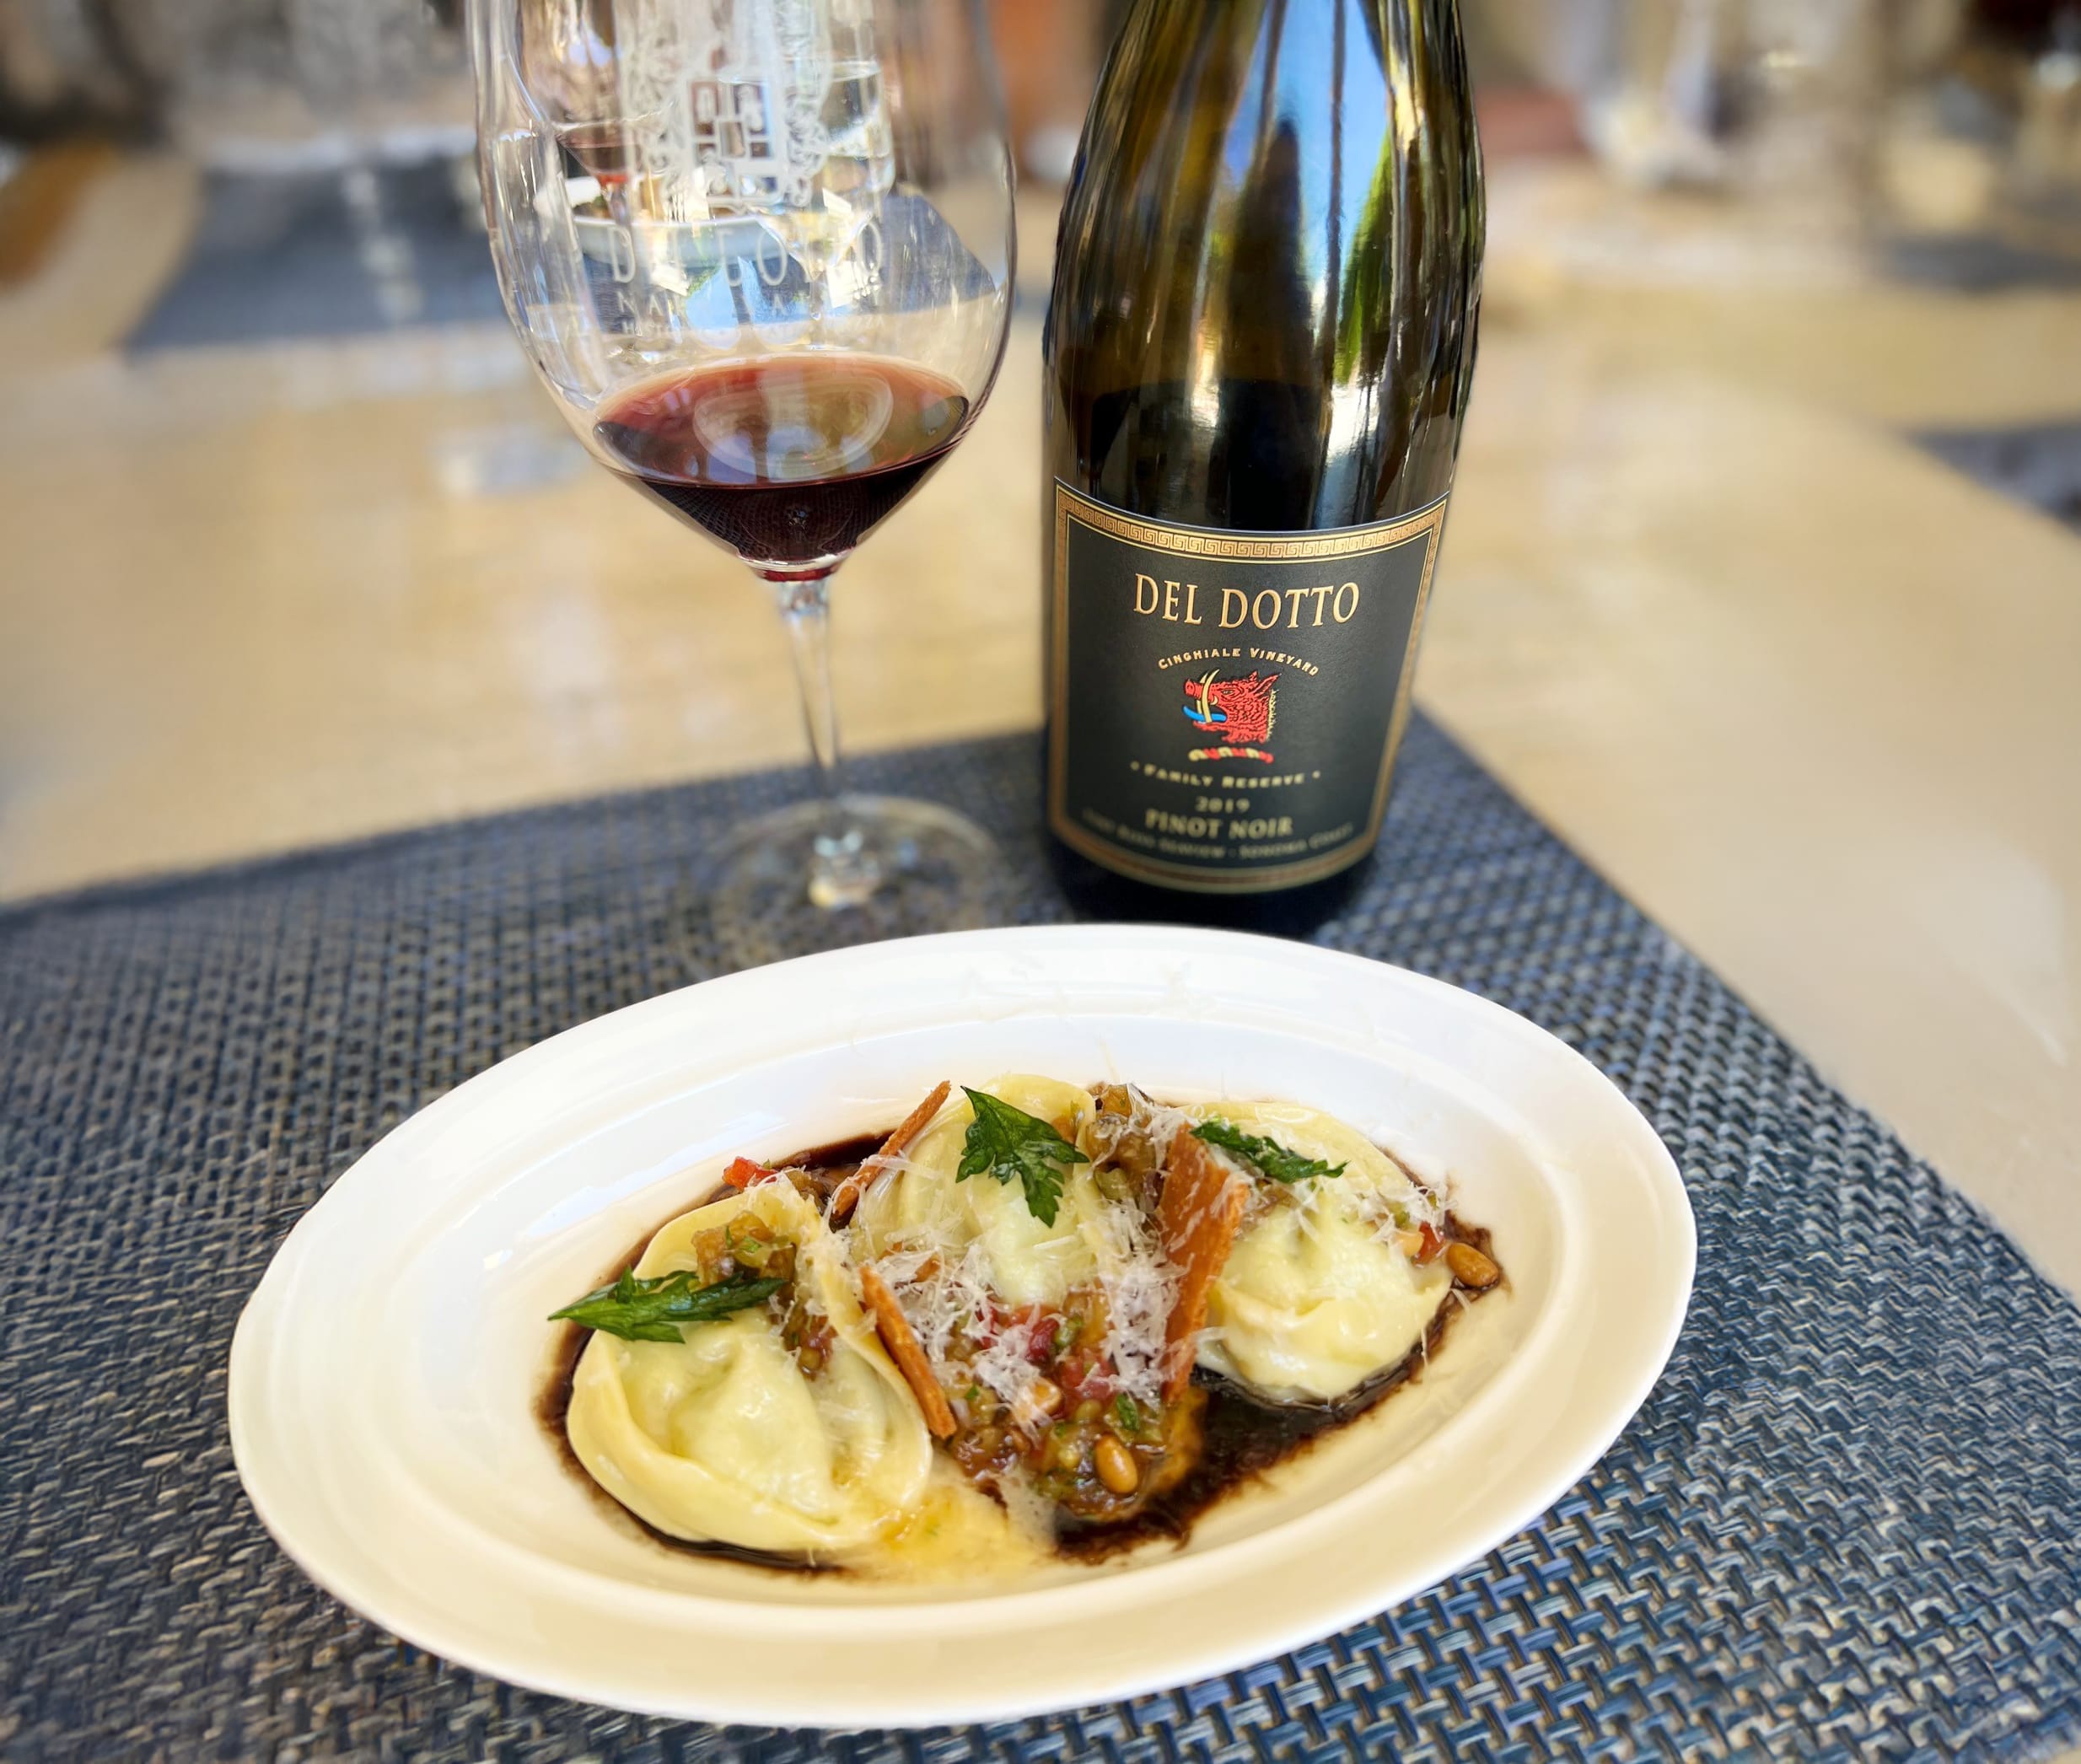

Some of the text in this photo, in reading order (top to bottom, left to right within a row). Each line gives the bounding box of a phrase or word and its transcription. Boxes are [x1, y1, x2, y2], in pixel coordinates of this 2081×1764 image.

[1133, 573, 1360, 630] DEL DOTTO
[1158, 648, 1320, 676] CINGHIALE VINEYARD
[1143, 763, 1304, 788] FAMILY RESERVE
[1195, 796, 1250, 814] 2019
[1145, 808, 1222, 839] PINOT
[1229, 815, 1293, 840] NOIR
